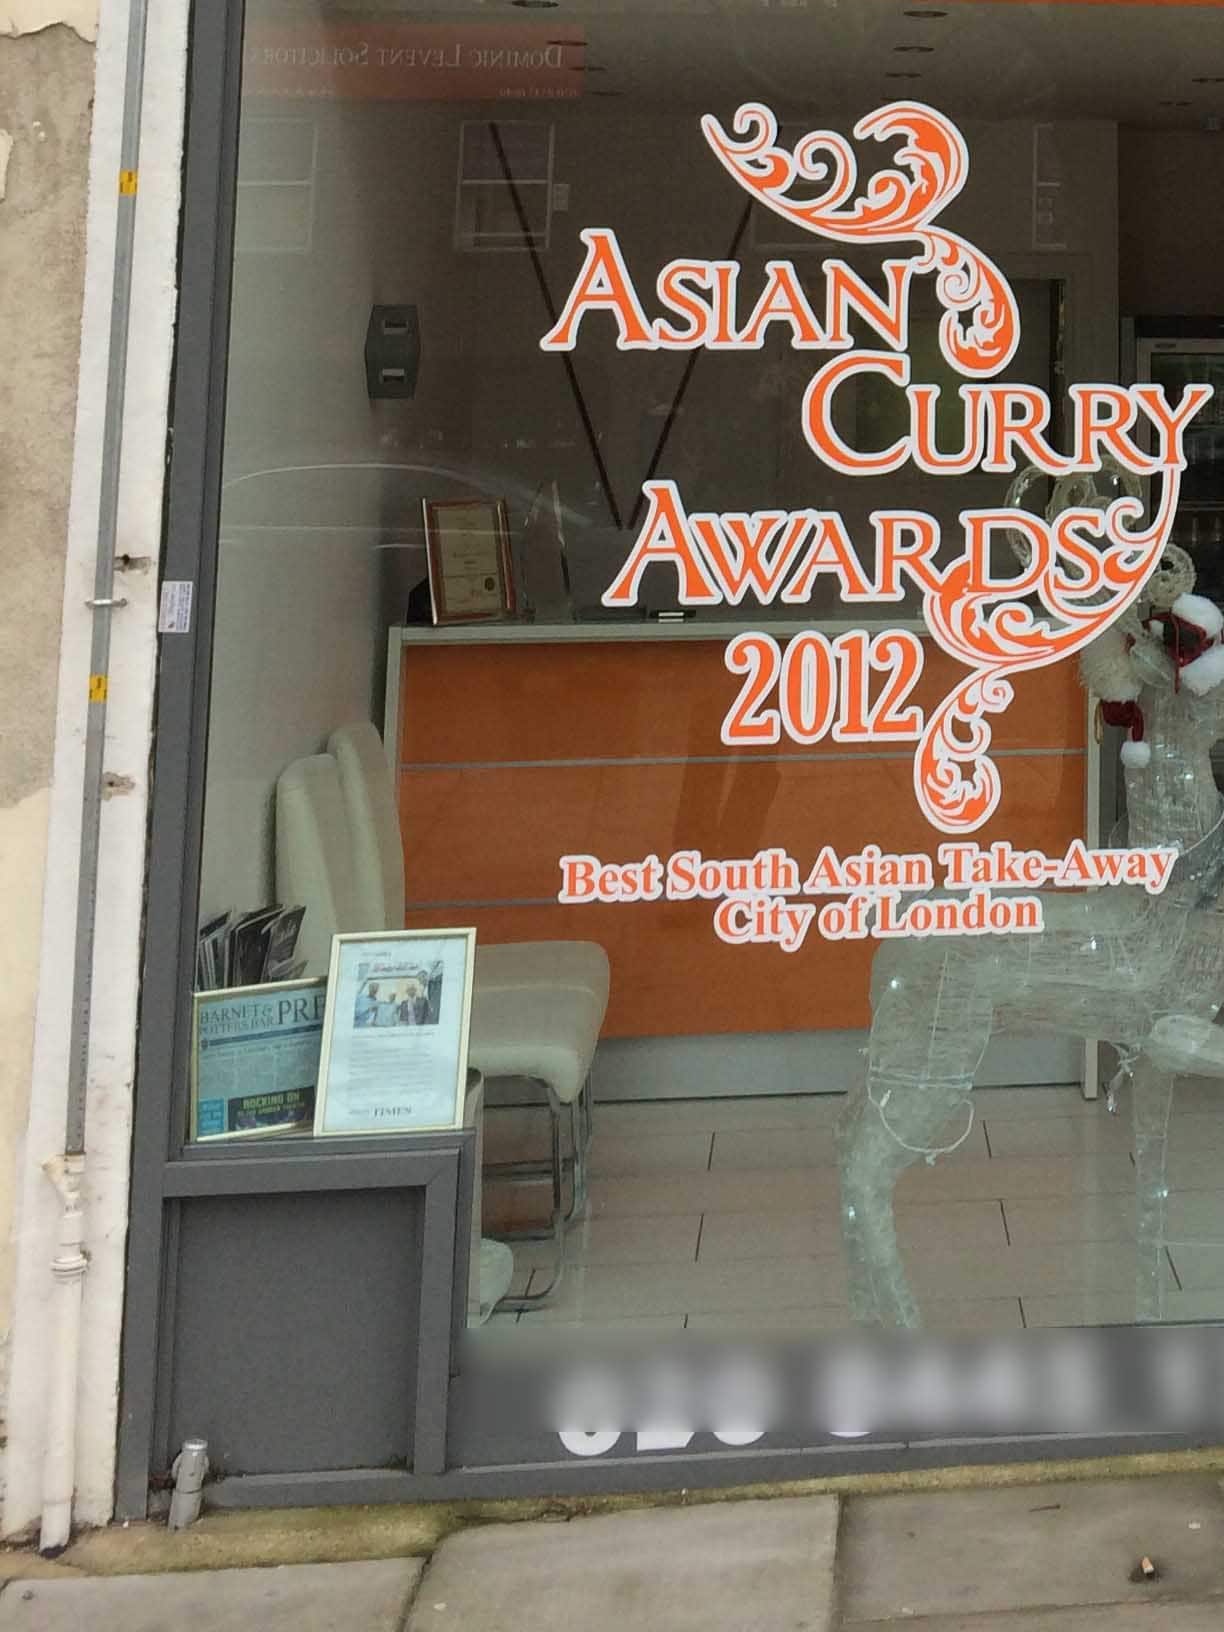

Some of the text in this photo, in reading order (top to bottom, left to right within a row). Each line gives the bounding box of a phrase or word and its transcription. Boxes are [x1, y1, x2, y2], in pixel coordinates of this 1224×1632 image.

[541, 229, 915, 351] ASIAN
[802, 349, 1214, 476] CURRY
[602, 480, 1106, 606] AWARDS
[722, 630, 925, 744] 2012
[559, 840, 1178, 903] Best South Asian Take-Away
[714, 890, 1044, 953] City of London
